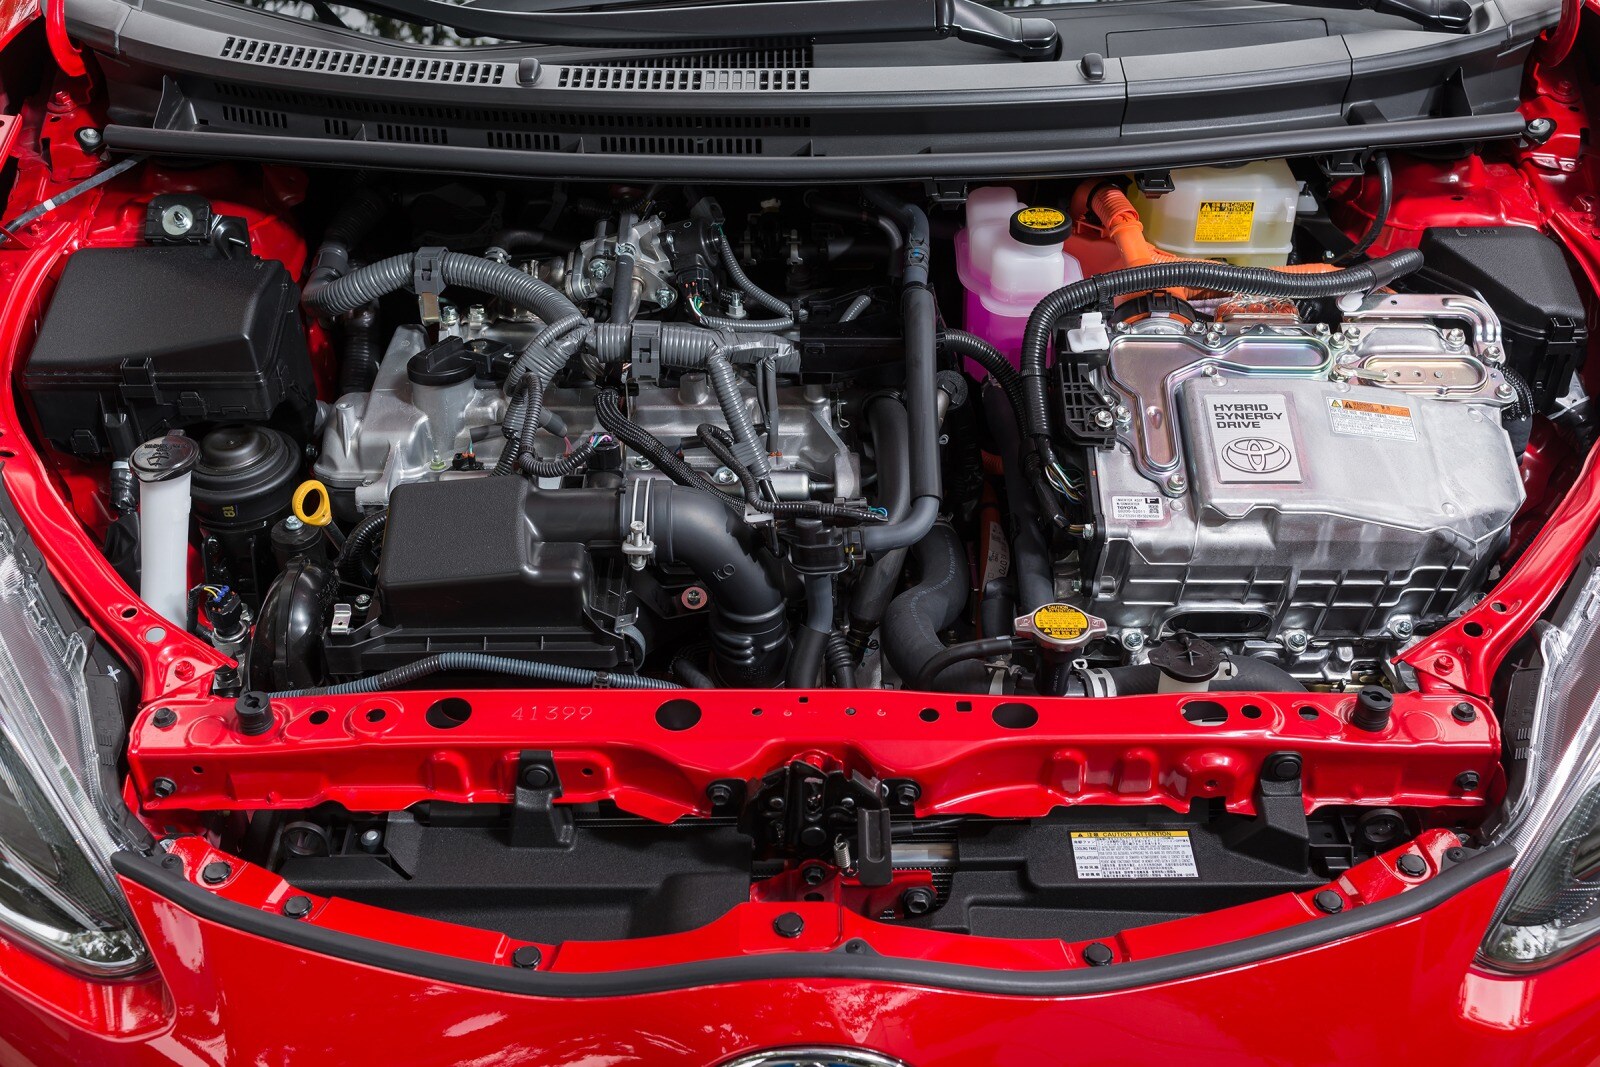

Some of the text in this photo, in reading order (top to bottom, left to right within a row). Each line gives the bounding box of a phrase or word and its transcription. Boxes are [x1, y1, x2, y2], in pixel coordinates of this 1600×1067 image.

[1213, 403, 1268, 412] HYBRID
[1214, 412, 1283, 420] SYNERGY
[1216, 421, 1261, 429] DRIVE
[511, 705, 593, 721] 41399
